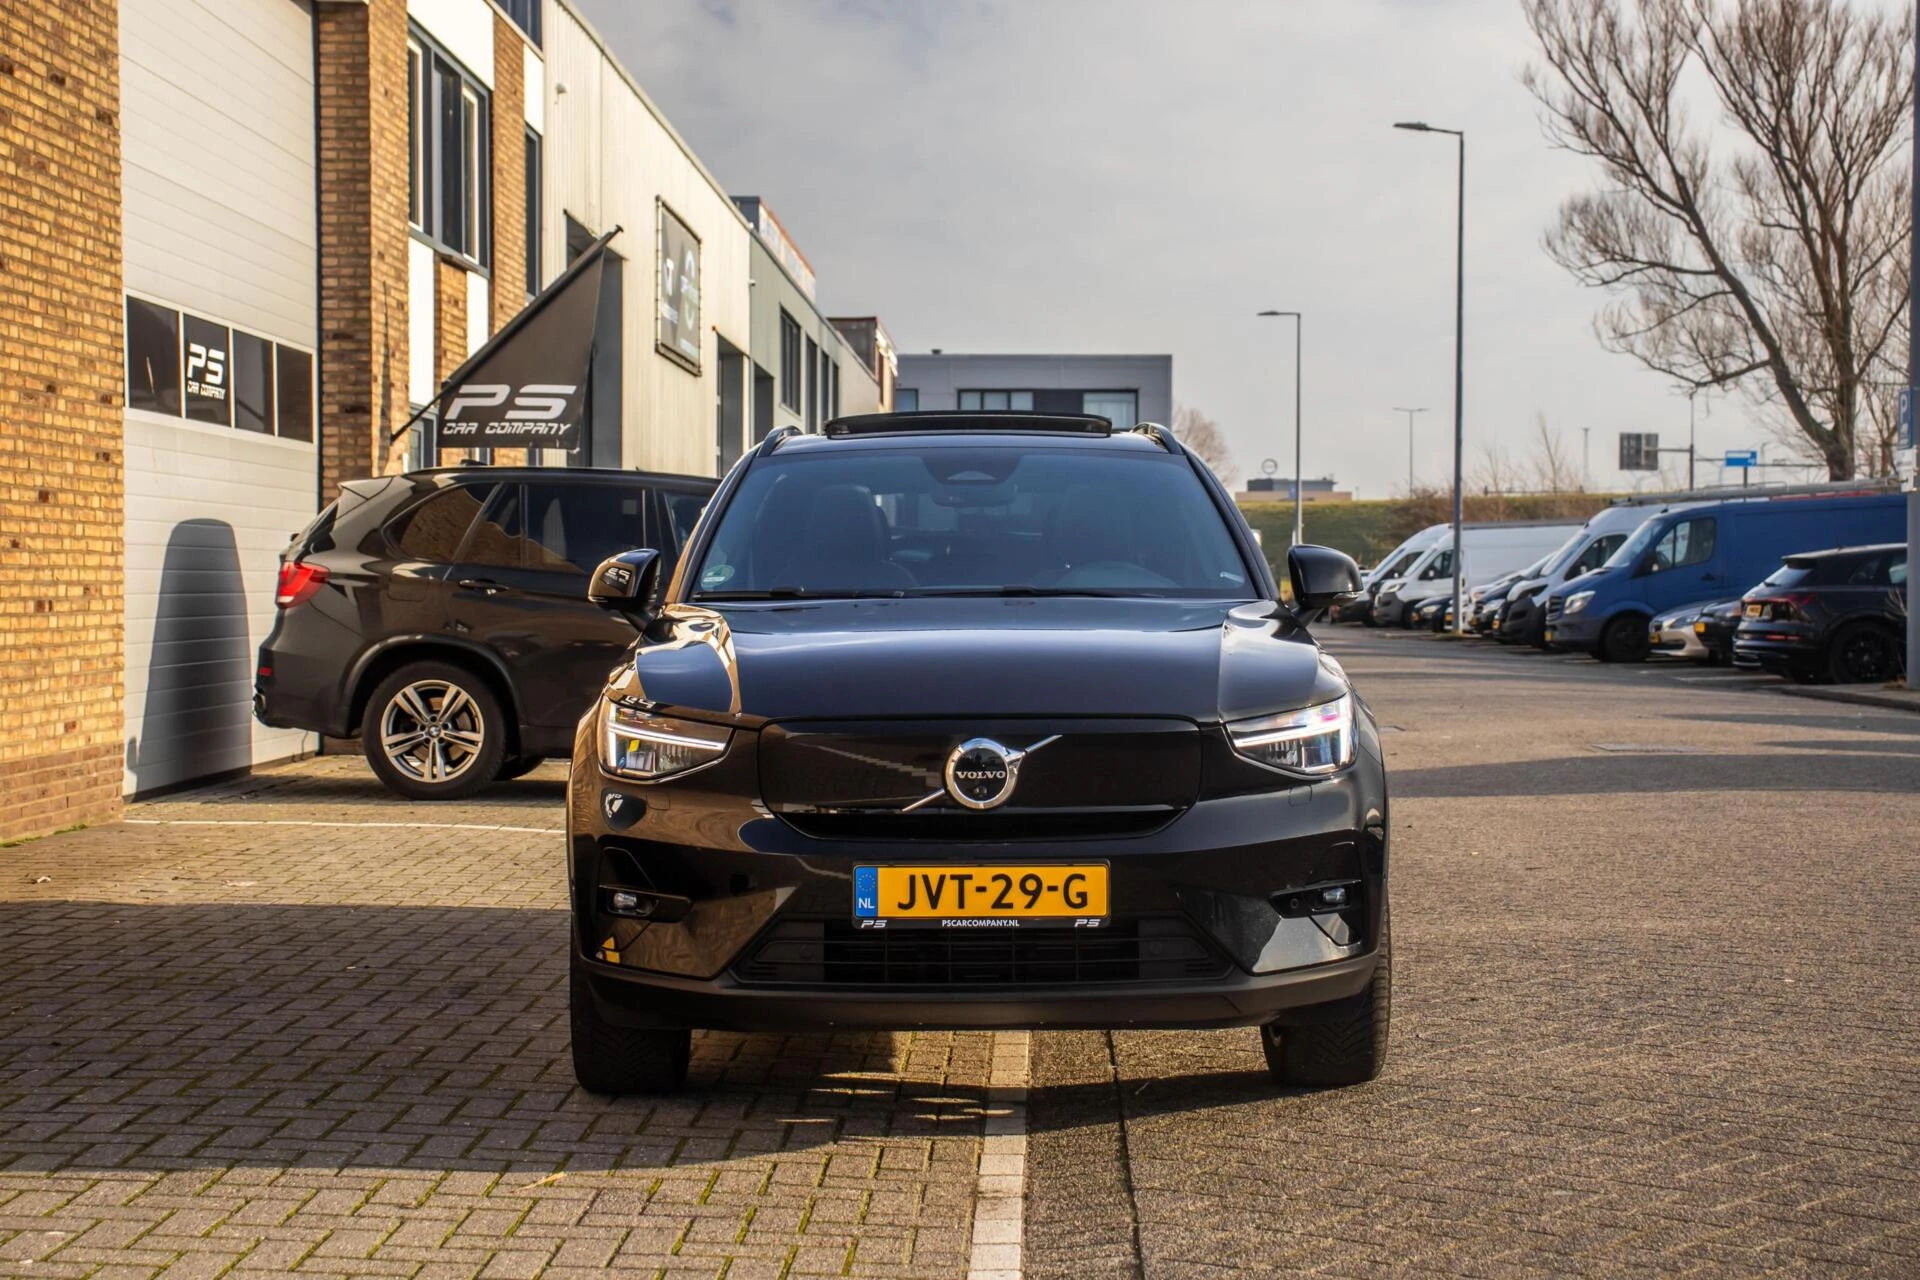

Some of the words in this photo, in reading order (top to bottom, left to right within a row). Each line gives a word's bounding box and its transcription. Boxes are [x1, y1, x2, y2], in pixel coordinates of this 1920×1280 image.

[187, 343, 225, 385] PS
[444, 384, 577, 420] PS
[442, 422, 479, 435] CAR
[485, 422, 571, 435] COMPANY
[956, 770, 1006, 779] VOLVO
[897, 873, 1089, 910] JVT-29-G
[858, 898, 875, 909] NL
[860, 919, 888, 928] PS
[941, 919, 1020, 928] PSCARCOMPANY.NL
[1073, 918, 1101, 928] PS
